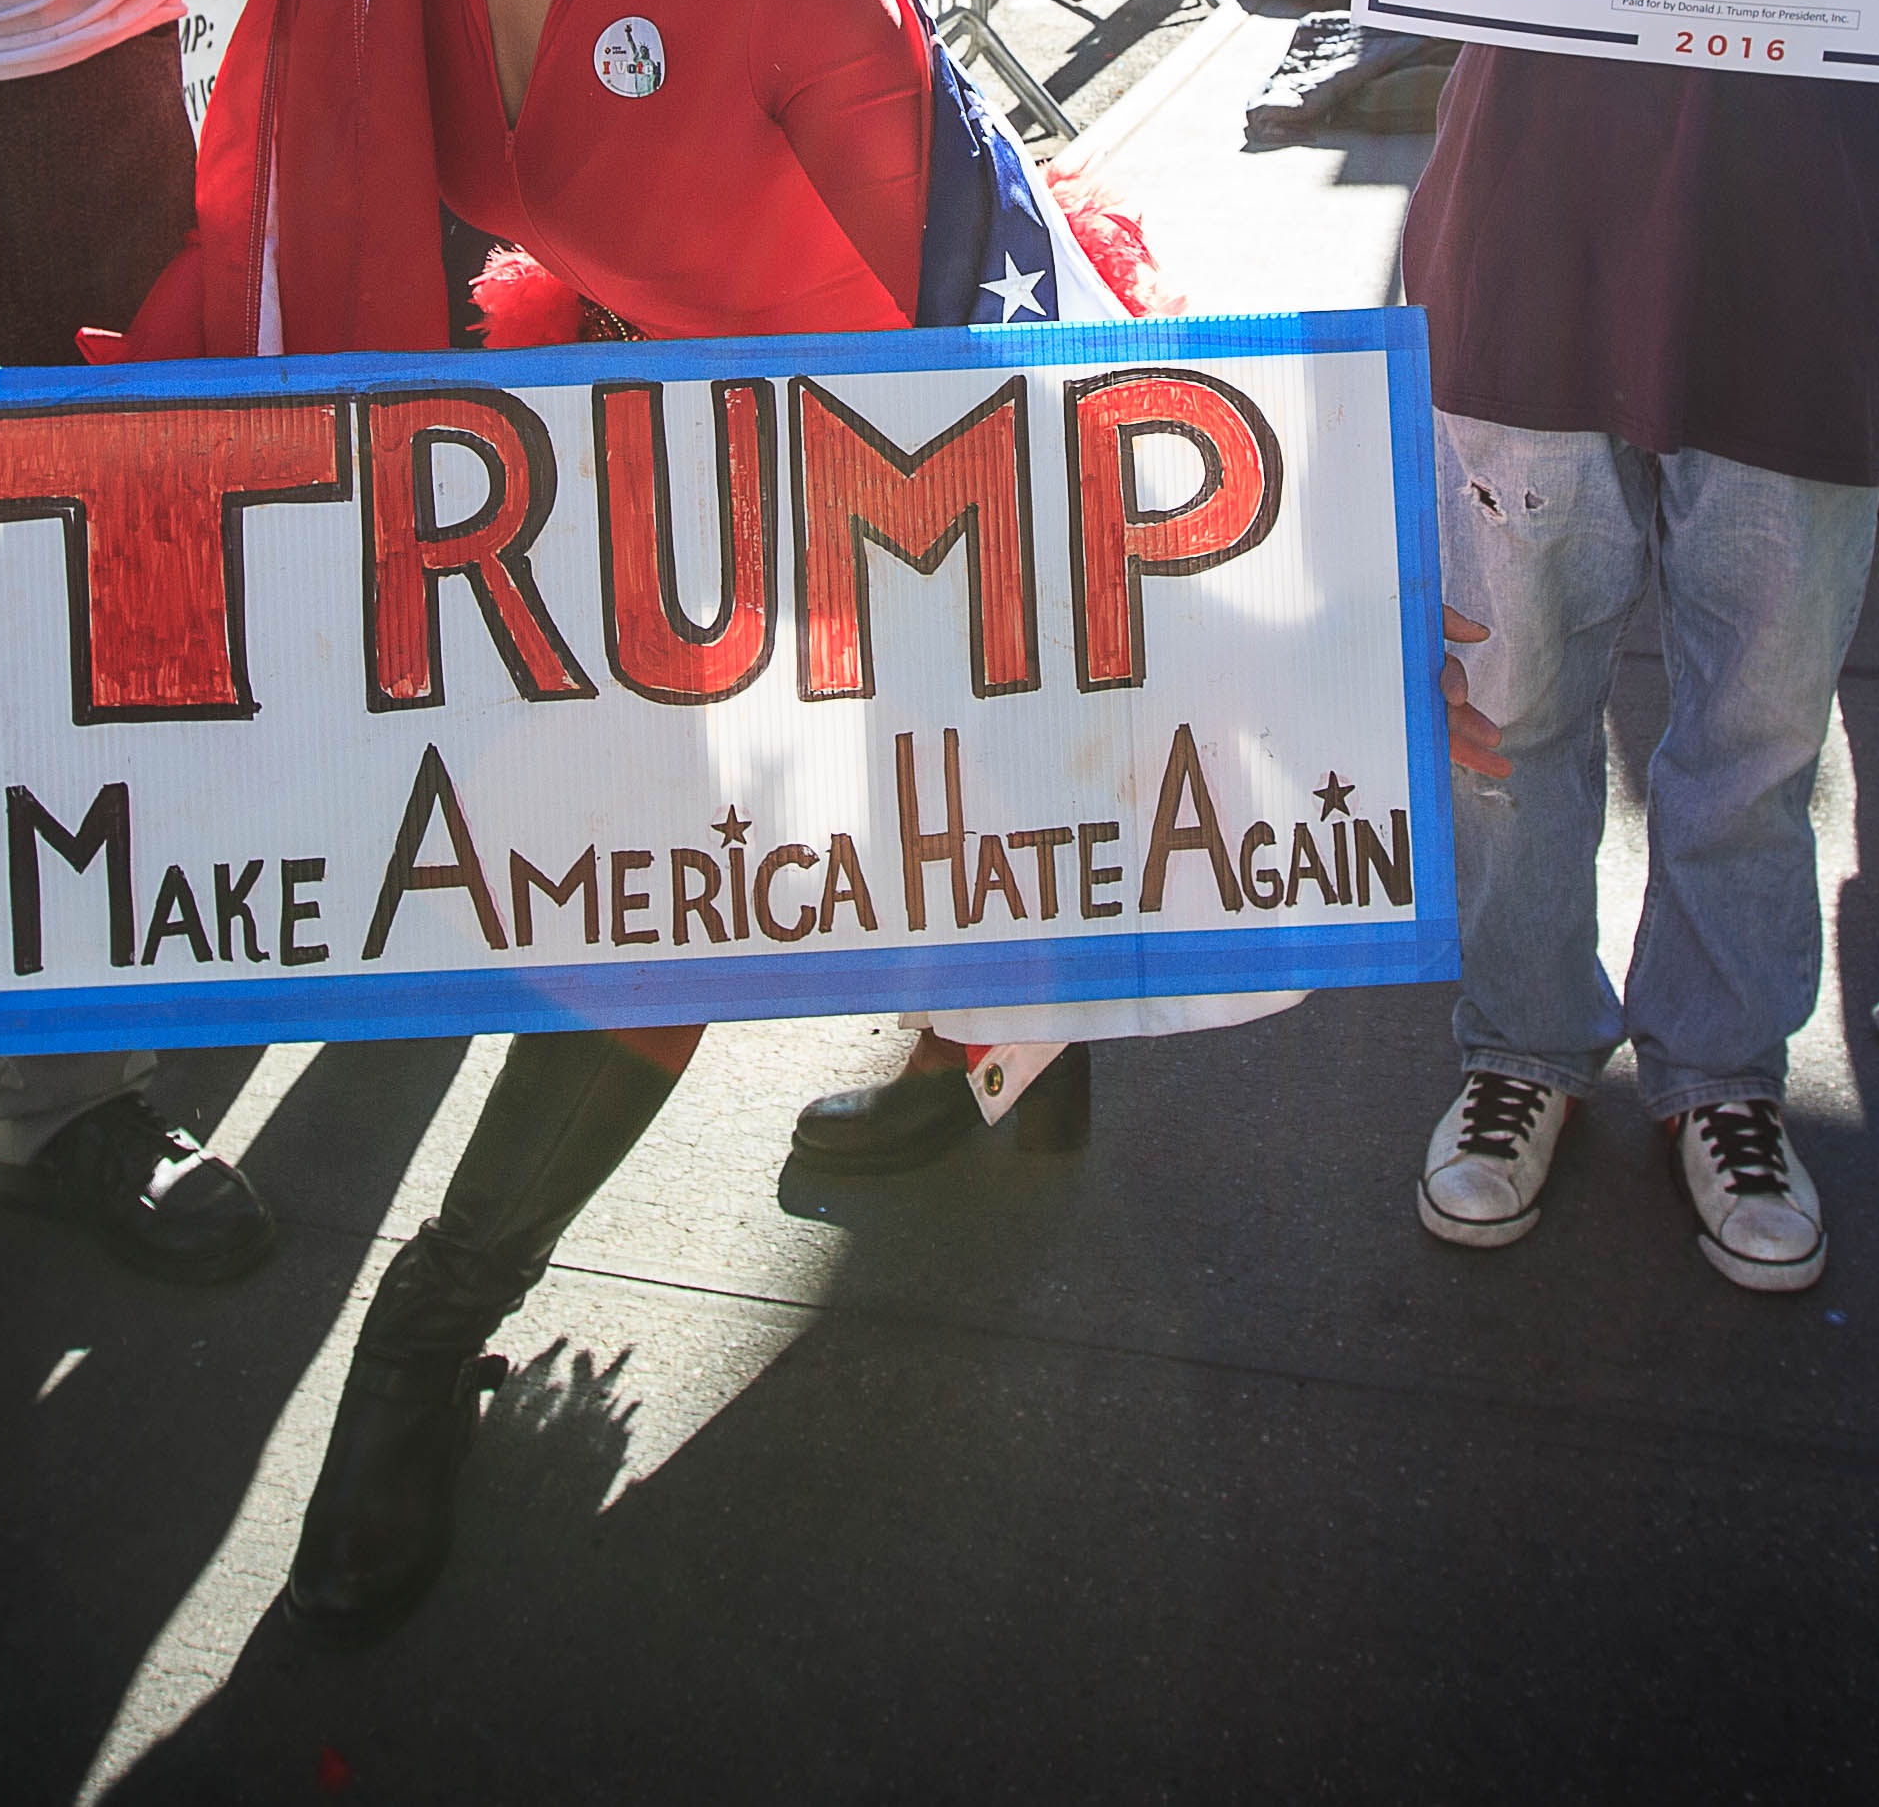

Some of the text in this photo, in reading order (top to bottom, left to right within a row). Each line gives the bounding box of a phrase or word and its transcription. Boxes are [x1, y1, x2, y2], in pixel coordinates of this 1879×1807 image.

[1663, 0, 1676, 12] by
[1678, 1, 1714, 14] Donald
[1716, 5, 1724, 15] J.
[1727, 6, 1760, 19] Trump
[1762, 7, 1776, 19] for
[1779, 10, 1829, 24] President,
[1831, 13, 1850, 24] Inc.
[1675, 31, 1786, 61] 2016
